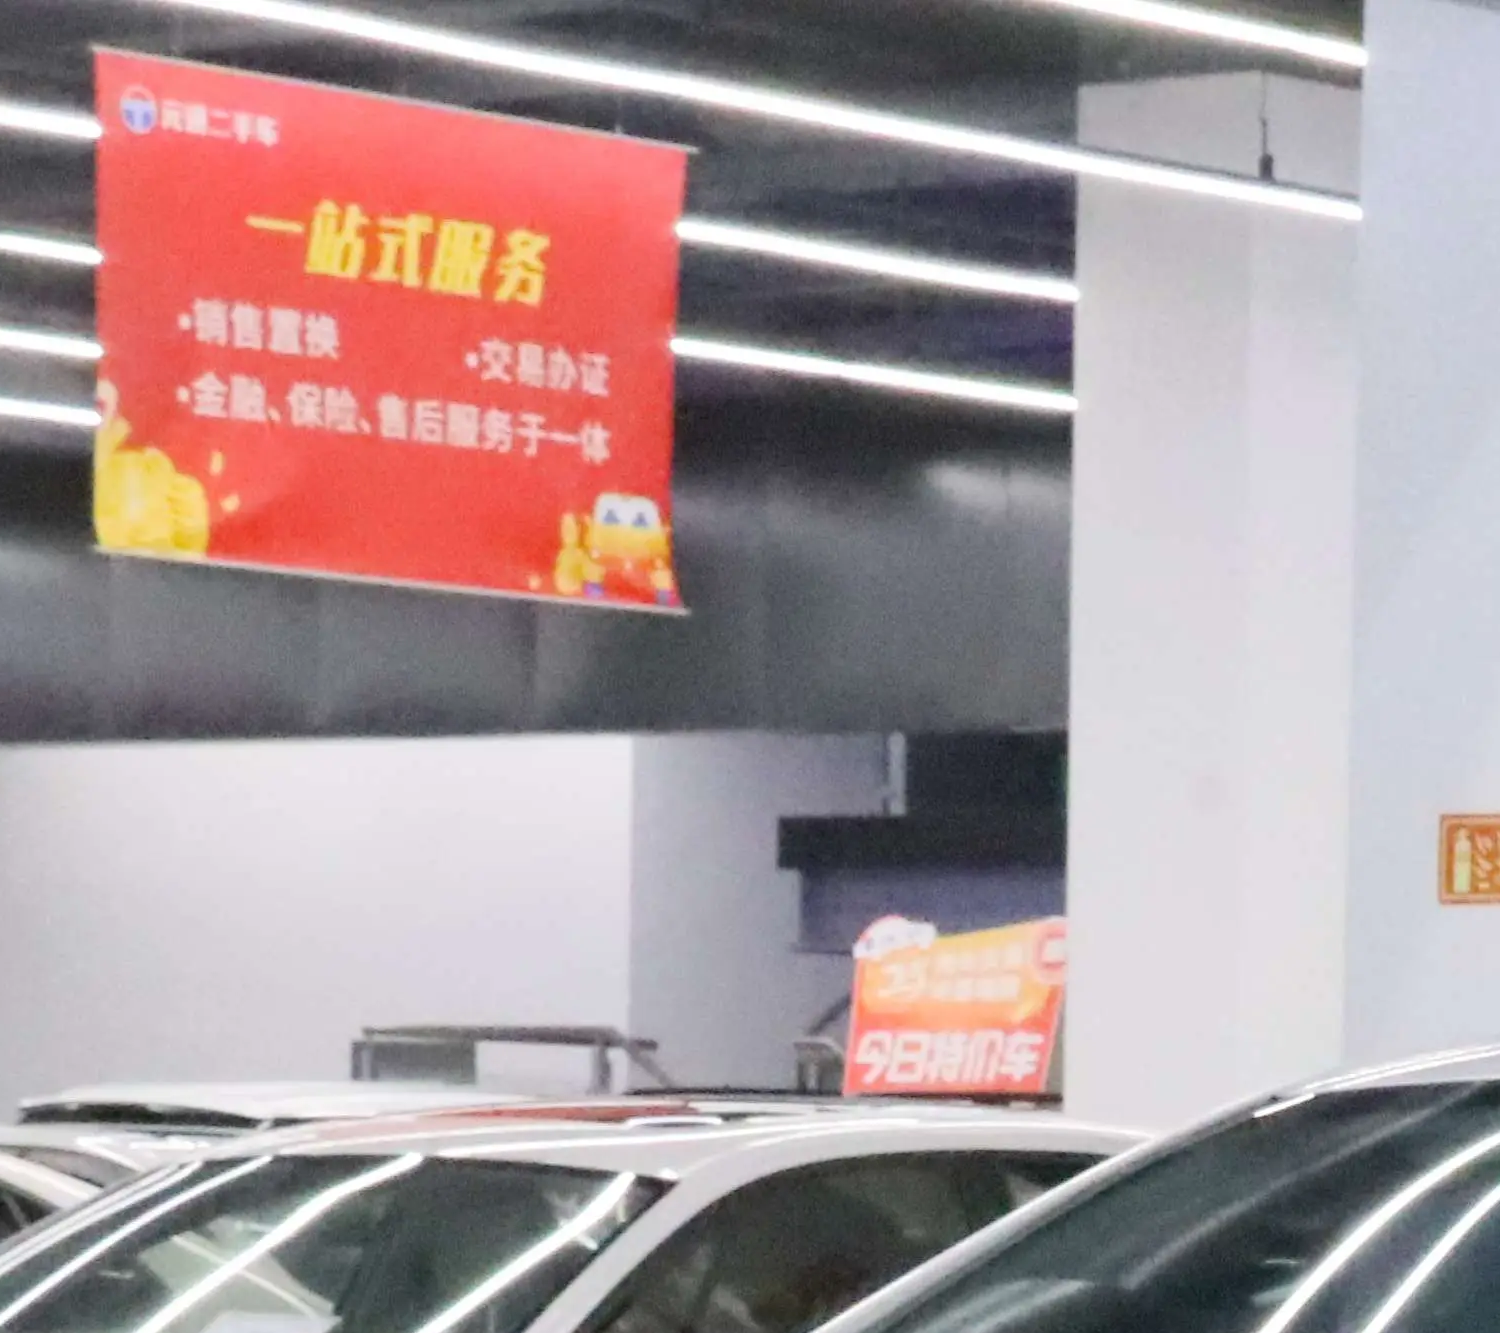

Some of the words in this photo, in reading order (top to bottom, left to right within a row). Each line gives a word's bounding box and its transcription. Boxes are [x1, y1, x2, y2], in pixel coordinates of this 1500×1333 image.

[245, 197, 551, 307] 一站式服务
[192, 297, 341, 361] 销售置换
[479, 338, 611, 398] 交易办证
[855, 1029, 1045, 1085] 今日特价车
